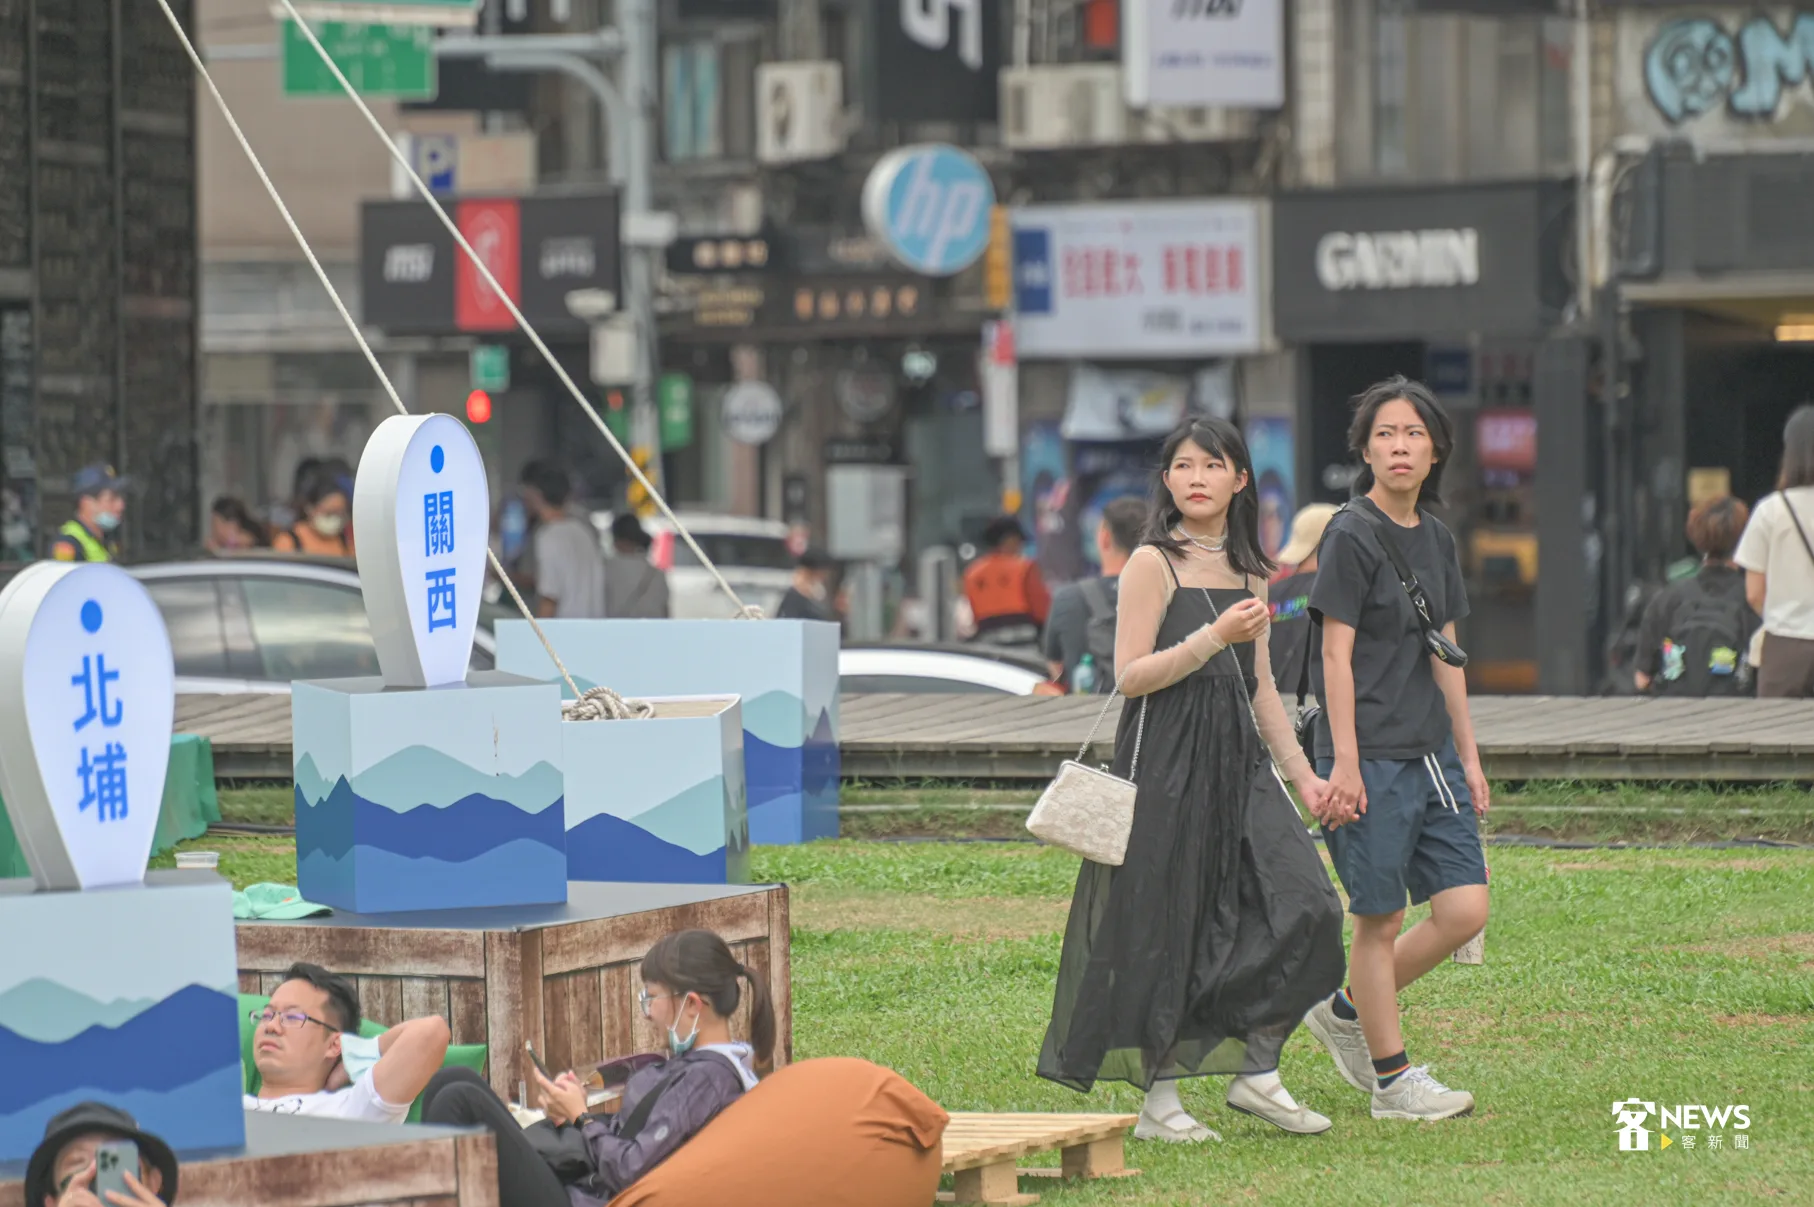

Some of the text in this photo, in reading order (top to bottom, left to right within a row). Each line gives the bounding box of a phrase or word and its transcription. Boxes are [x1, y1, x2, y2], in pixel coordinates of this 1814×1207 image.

[894, 152, 983, 272] hp
[1316, 227, 1479, 291] GARMIN
[423, 490, 457, 633] 關西
[71, 653, 129, 823] 北埔
